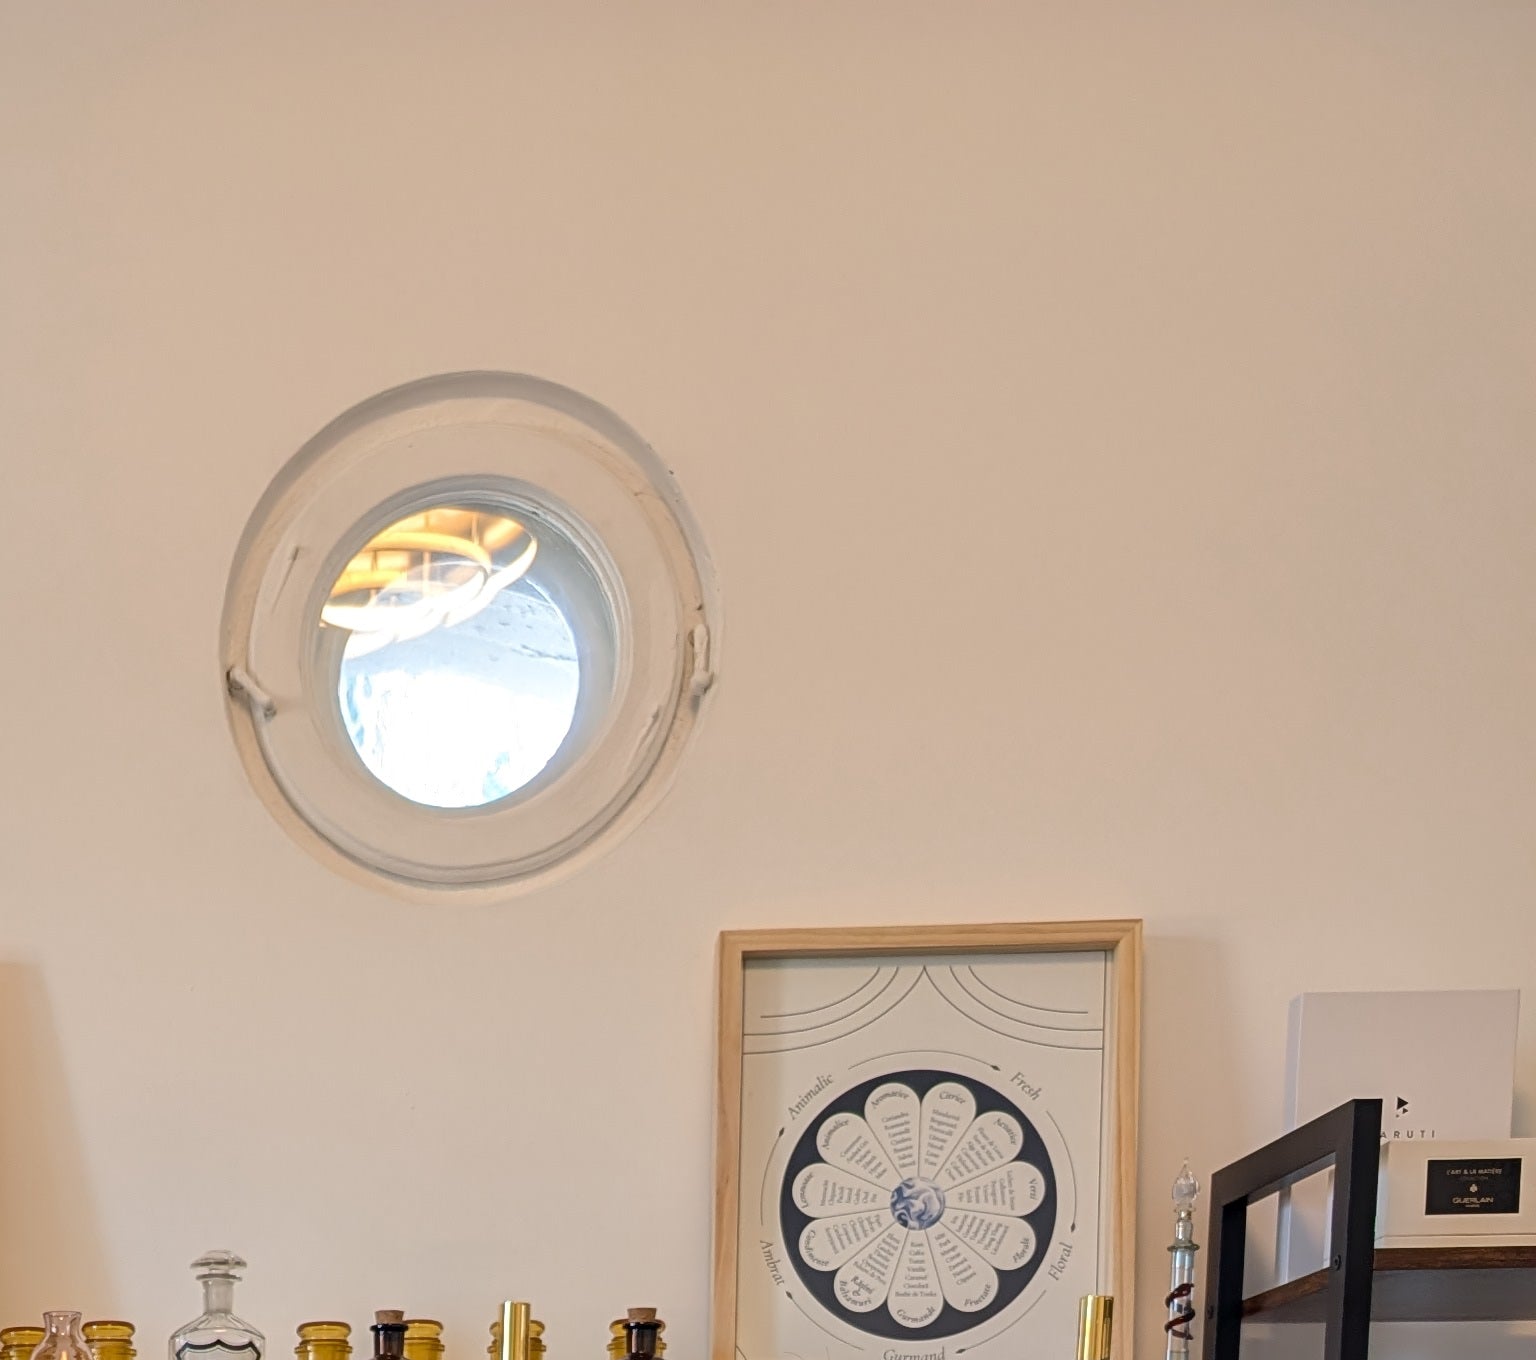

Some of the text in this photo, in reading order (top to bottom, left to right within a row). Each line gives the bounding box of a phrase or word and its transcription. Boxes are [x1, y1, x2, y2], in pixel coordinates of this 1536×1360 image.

[788, 1073, 834, 1120] Animalic
[1009, 1071, 1042, 1101] Fresh
[1380, 1130, 1434, 1138] ARUTI
[1451, 1196, 1493, 1204] GUERLAIN
[760, 1239, 785, 1287] Ambrat
[1048, 1242, 1074, 1282] Floral
